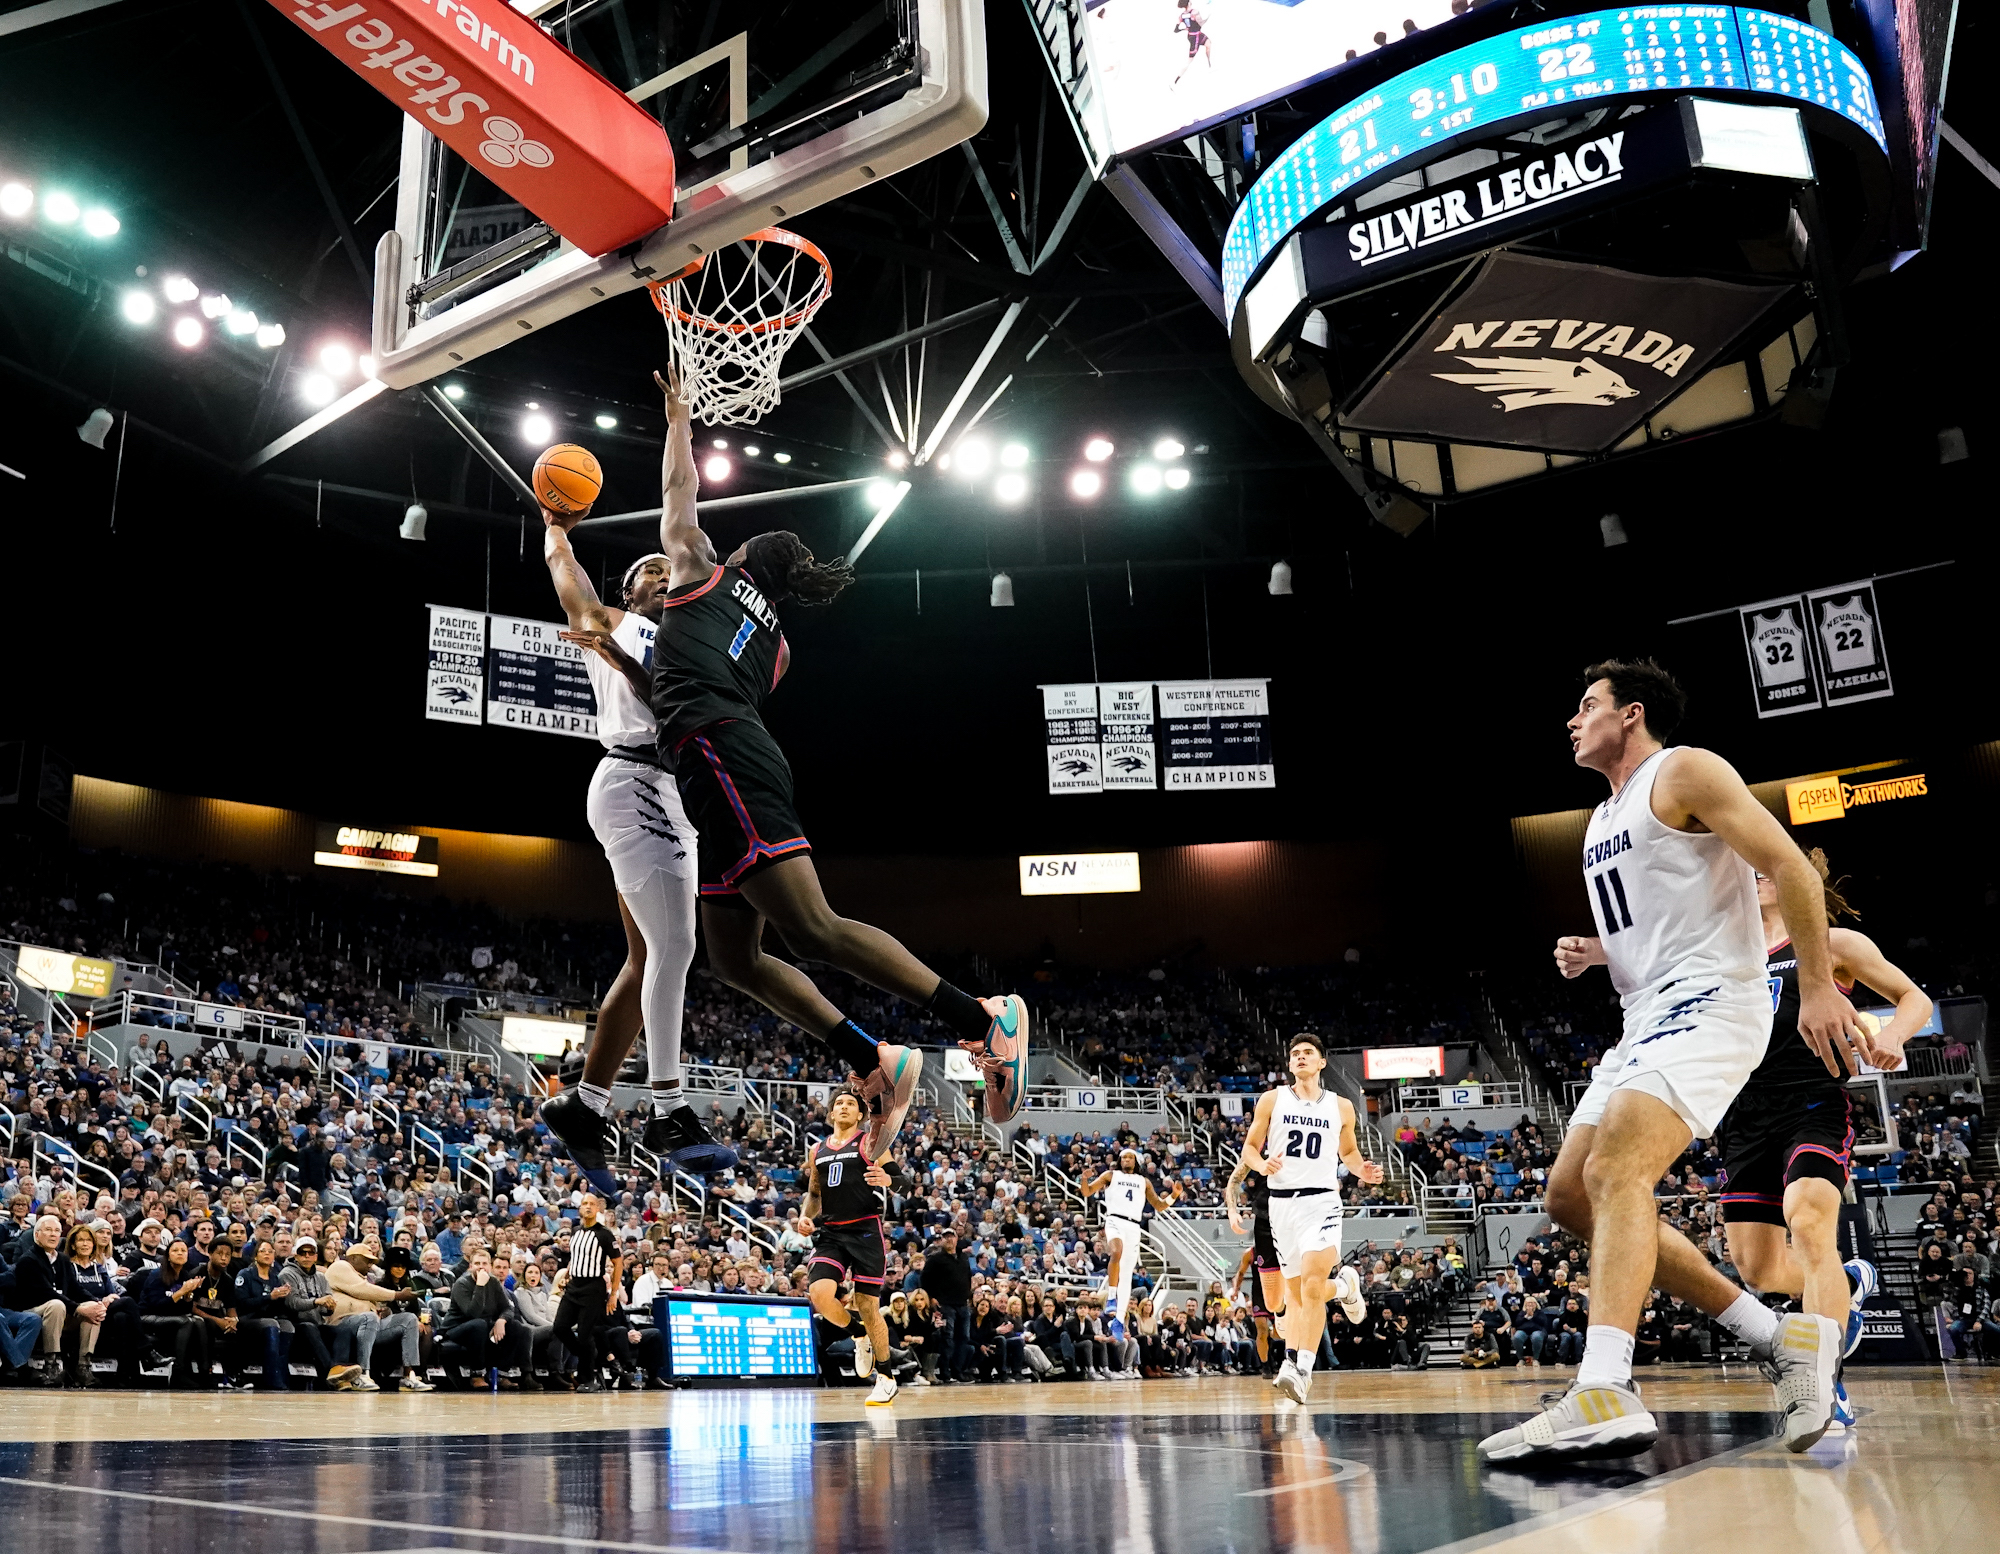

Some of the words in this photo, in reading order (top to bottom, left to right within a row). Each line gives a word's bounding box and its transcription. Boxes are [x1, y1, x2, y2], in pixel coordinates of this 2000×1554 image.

[1521, 25, 1573, 50] BOISE
[1577, 20, 1600, 37] ST
[1538, 43, 1595, 83] 22
[1409, 63, 1499, 121] 3:10
[1849, 74, 1874, 118] 21
[1331, 94, 1383, 135] NEVADA
[1440, 107, 1474, 131] 1ST
[1339, 118, 1379, 165] 21
[1348, 190, 1475, 261] SILVER
[1477, 131, 1624, 219] LEGACY
[1433, 318, 1695, 378] NEVADA
[731, 578, 780, 632] STANLEY
[439, 616, 478, 631] PACIFIC
[1826, 613, 1867, 630] NEVADA
[433, 627, 482, 643] ATHLETIC
[512, 622, 542, 639] FAR
[728, 612, 758, 662] 1
[1758, 627, 1796, 643] NEVADA
[432, 639, 483, 653] ASSOCIATION
[1834, 628, 1865, 652] 22
[436, 651, 479, 666] 1919-20
[1765, 641, 1795, 666] 32
[429, 660, 483, 676] CHAMPIONS
[431, 675, 479, 693] NEVADA
[1826, 670, 1887, 690] FAZEKAS
[1118, 691, 1134, 700] BIG
[1166, 691, 1211, 700] WESTERN
[1215, 689, 1261, 698] ATHLETIC
[1767, 684, 1806, 700] JONES
[428, 706, 479, 719] BASKETBALL
[1047, 708, 1096, 716] CONFERENCE
[1113, 702, 1140, 711] WEST
[1184, 702, 1245, 712] CONFERENCE
[1107, 725, 1148, 735] 1996-97
[1050, 736, 1097, 744] CHAMPIONS
[1102, 734, 1154, 743] CHAMPIONS
[1051, 749, 1098, 764] NEVADA
[1106, 745, 1152, 760] NEVADA
[1105, 776, 1154, 784] BASKETBALL
[1172, 770, 1268, 784] CHAMPIONS
[1798, 787, 1838, 814] ASPEN
[1840, 776, 1929, 809] EARTHWORKS
[336, 826, 420, 854] CAMPAGNI
[341, 846, 372, 857] AUTO
[1028, 860, 1078, 878] NSN
[1593, 866, 1634, 936] 11
[1768, 960, 1798, 972] STAT
[214, 1010, 225, 1023] 6
[371, 1051, 381, 1063] 7
[814, 1090, 824, 1102] 9
[1078, 1092, 1096, 1106] 10
[1452, 1090, 1470, 1104] 12
[1228, 1100, 1237, 1111] 11
[1283, 1114, 1330, 1130] NEVADA
[1285, 1129, 1322, 1160] 20
[828, 1161, 843, 1187] 0
[1117, 1181, 1140, 1189] NEVADA
[1125, 1189, 1134, 1202] 4
[1872, 1324, 1903, 1334] LEXUS
